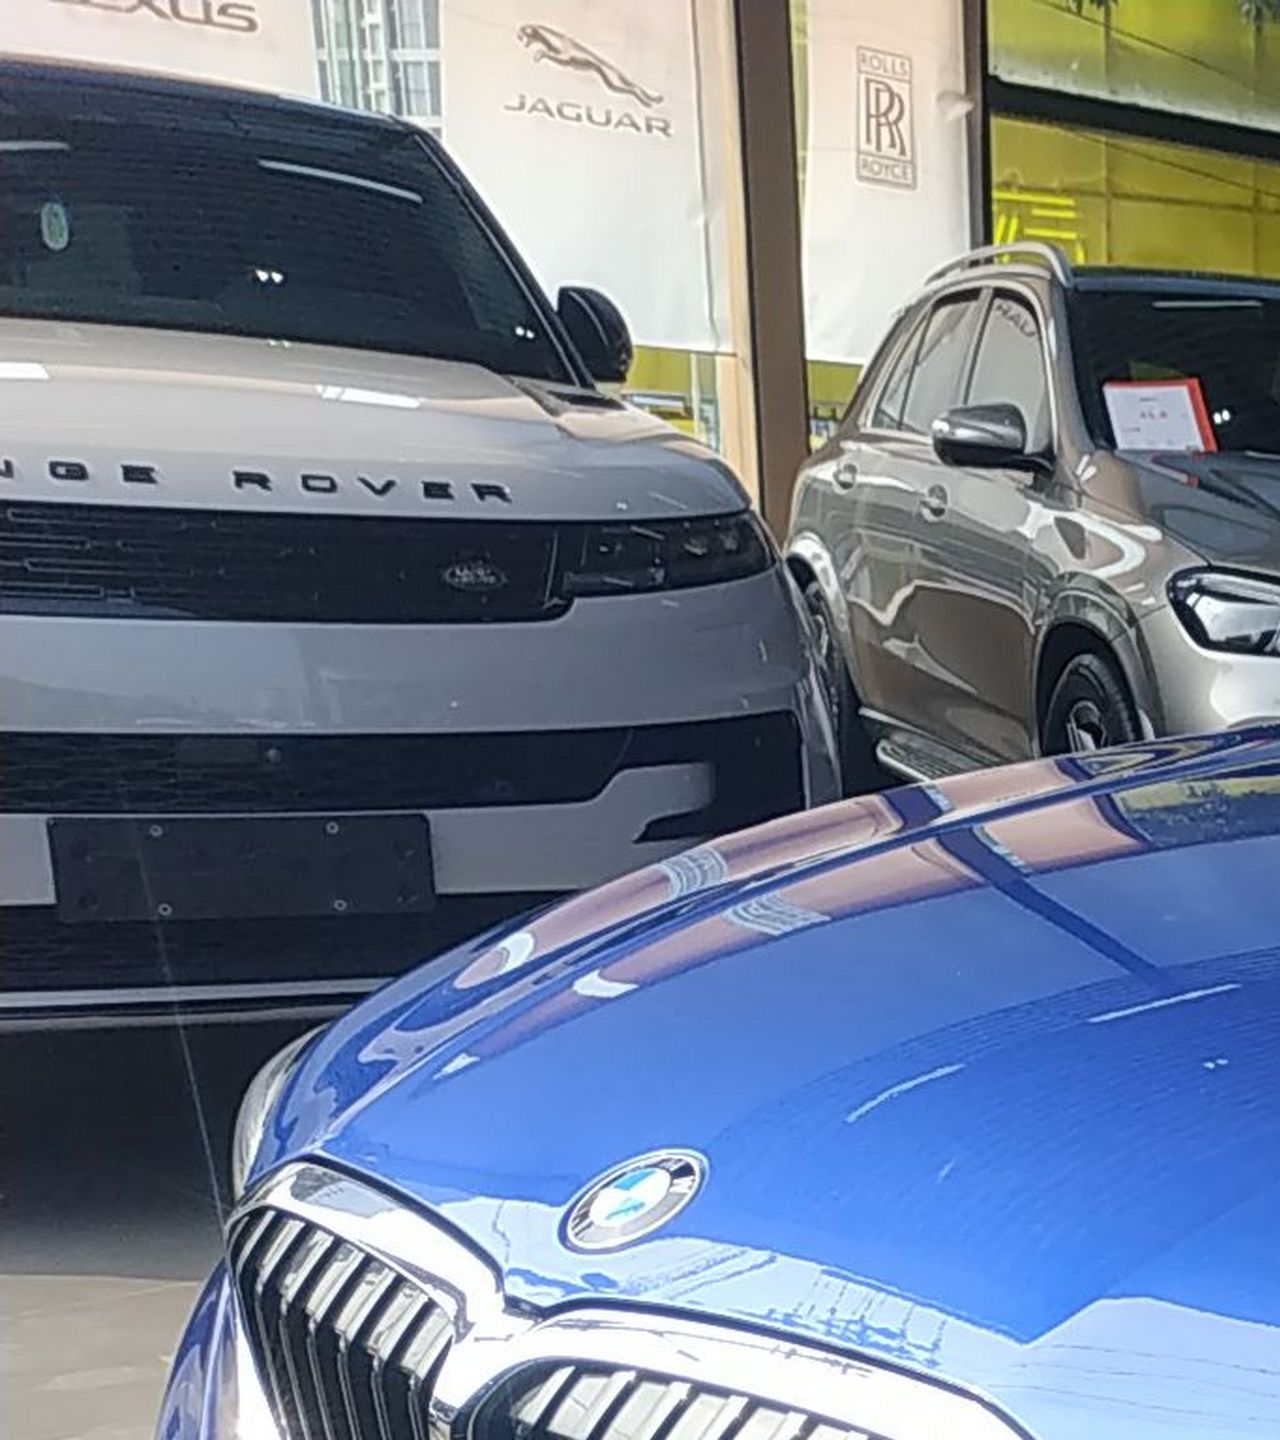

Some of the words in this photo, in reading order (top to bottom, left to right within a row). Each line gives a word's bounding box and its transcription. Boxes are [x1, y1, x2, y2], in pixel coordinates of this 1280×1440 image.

[860, 51, 908, 77] ROLLS
[503, 94, 672, 138] JAGUAR
[861, 157, 911, 181] ROYCE
[232, 470, 513, 503] ROVER
